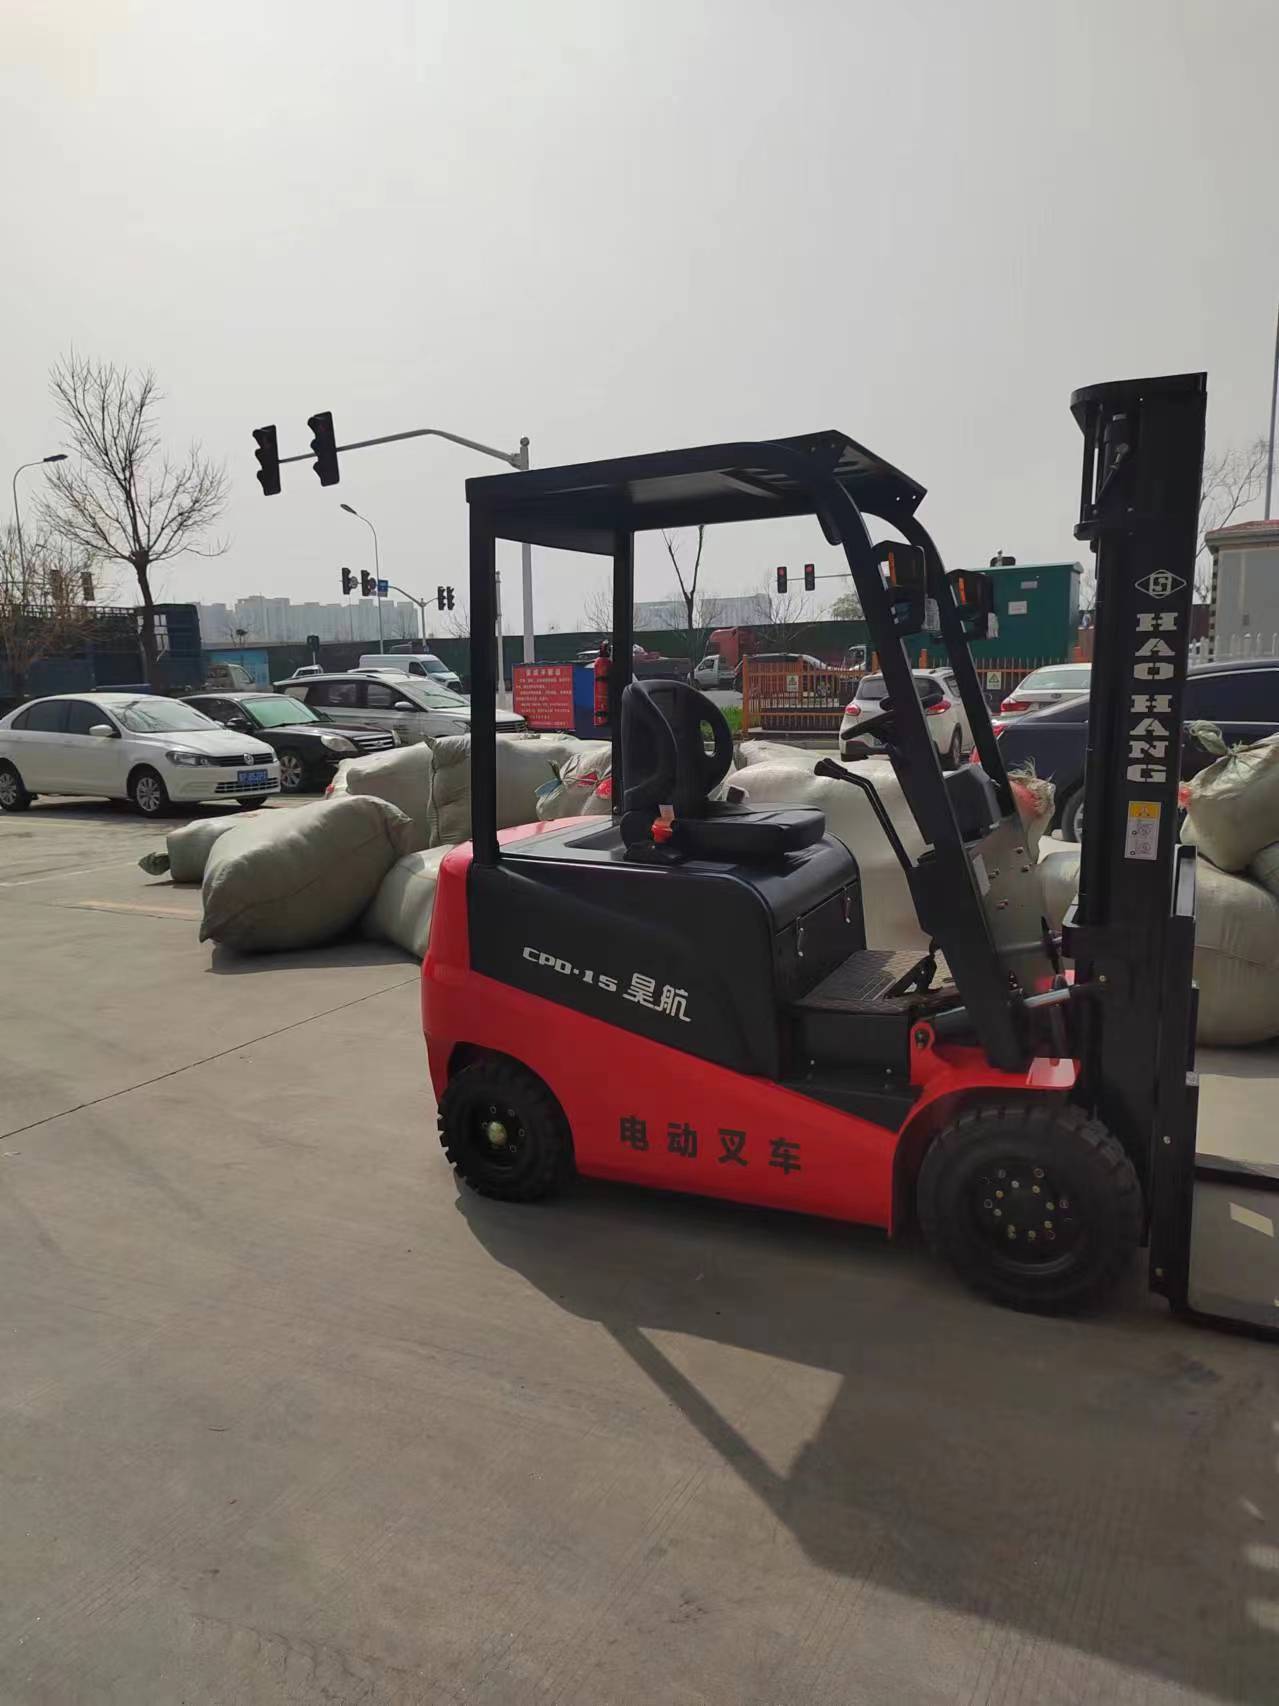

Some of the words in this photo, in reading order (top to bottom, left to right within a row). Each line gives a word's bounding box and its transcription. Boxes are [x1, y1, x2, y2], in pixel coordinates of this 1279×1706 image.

[1133, 612, 1178, 680] HAO
[1126, 694, 1173, 783] HANG
[622, 972, 692, 1022] 昊航
[619, 1115, 802, 1175] 电动叉车
